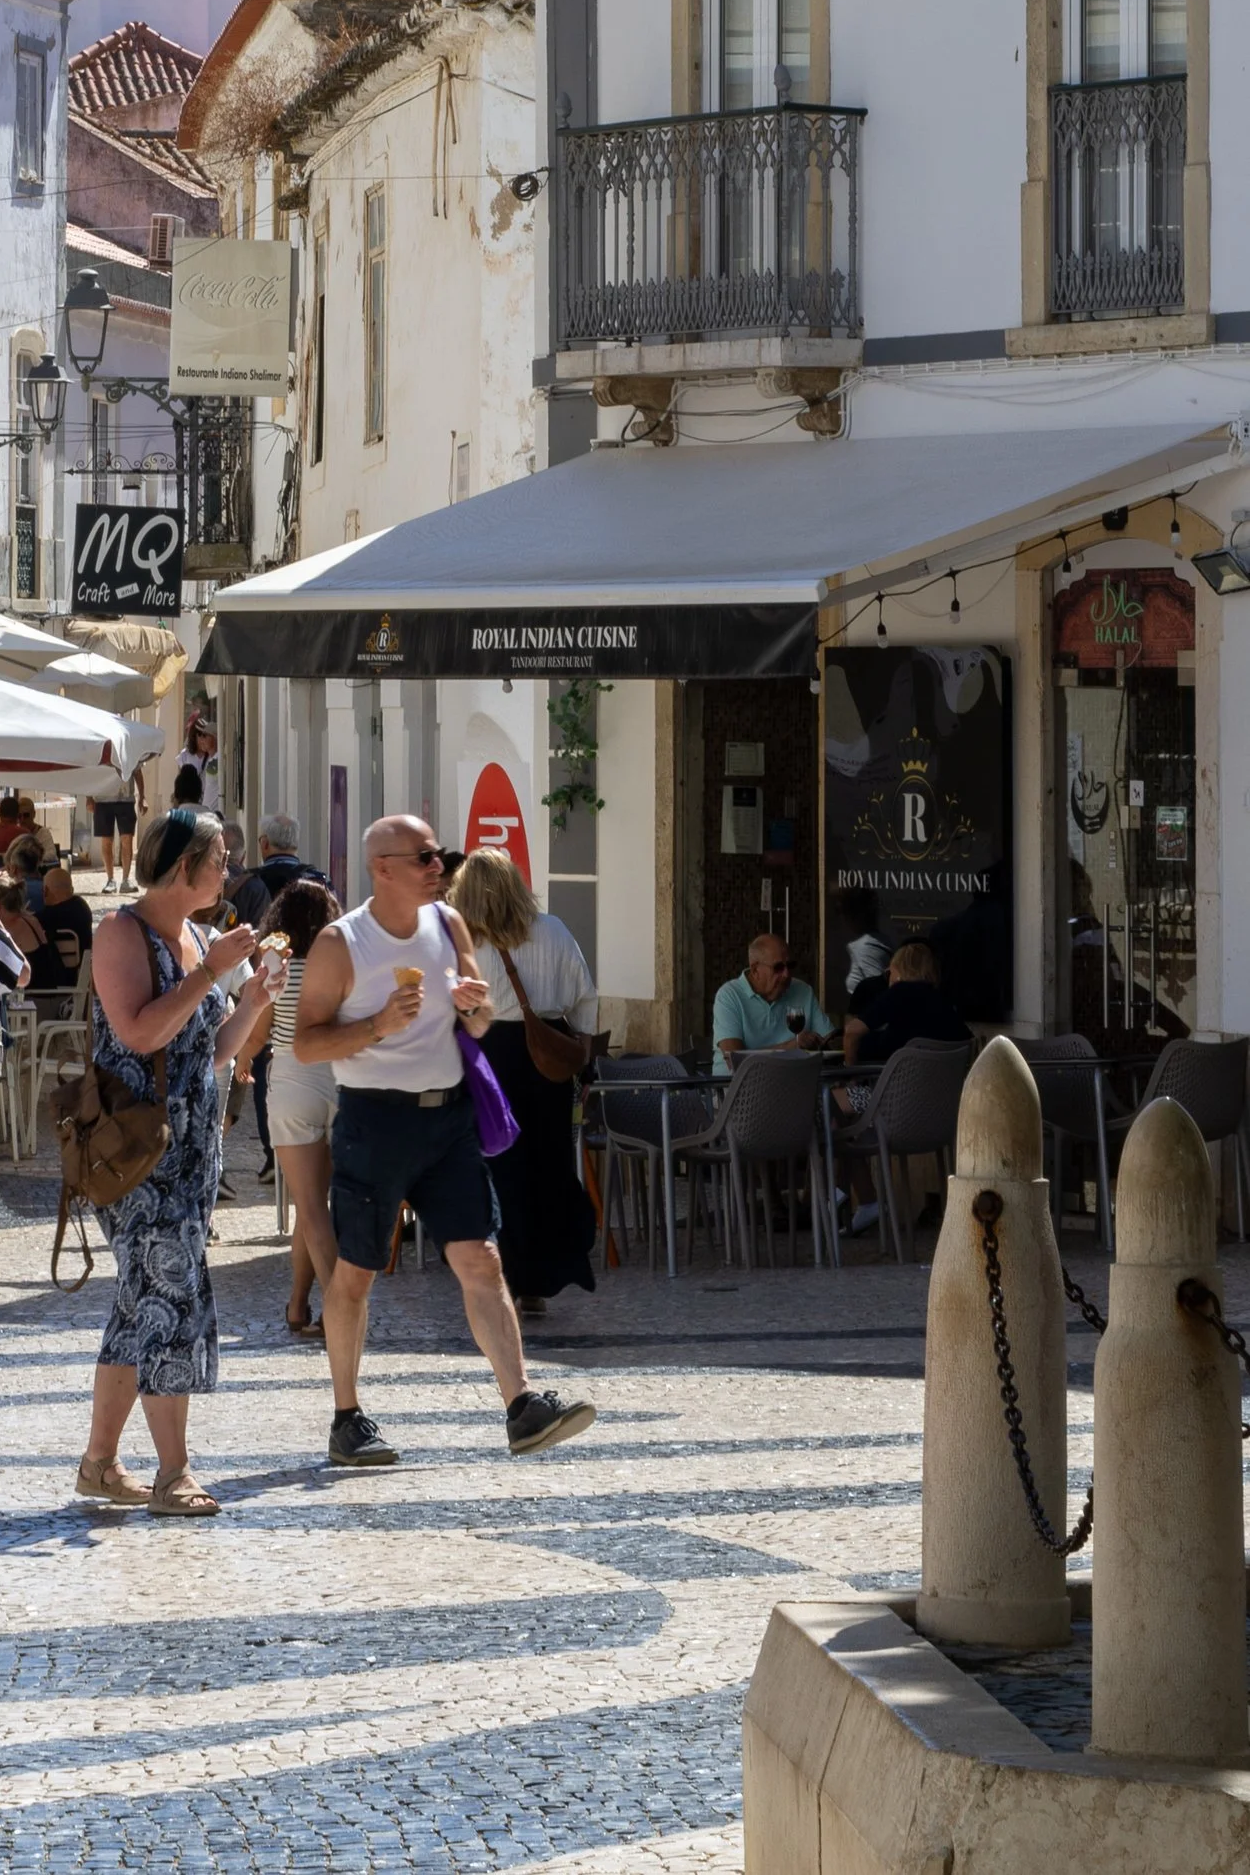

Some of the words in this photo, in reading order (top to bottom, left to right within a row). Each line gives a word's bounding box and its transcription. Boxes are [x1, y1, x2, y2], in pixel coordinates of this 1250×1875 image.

[177, 365, 219, 379] Restaurante
[220, 367, 248, 380] Indiano
[249, 369, 282, 381] Shalimar
[77, 512, 179, 585] MQ
[77, 581, 111, 603] Craft
[120, 585, 135, 595] and
[142, 584, 176, 606] More
[379, 631, 387, 647] R
[471, 628, 519, 650] ROYAL
[520, 627, 575, 649] INDIAN
[576, 626, 638, 648] CUISINE
[1095, 626, 1138, 644] HALAL
[510, 656, 547, 668] TANDOORI
[547, 656, 593, 668] RESTAURANT
[902, 793, 928, 842] R
[838, 869, 882, 889] ROYAL
[885, 870, 933, 891] INDIAN
[936, 872, 991, 893] CUISINE
